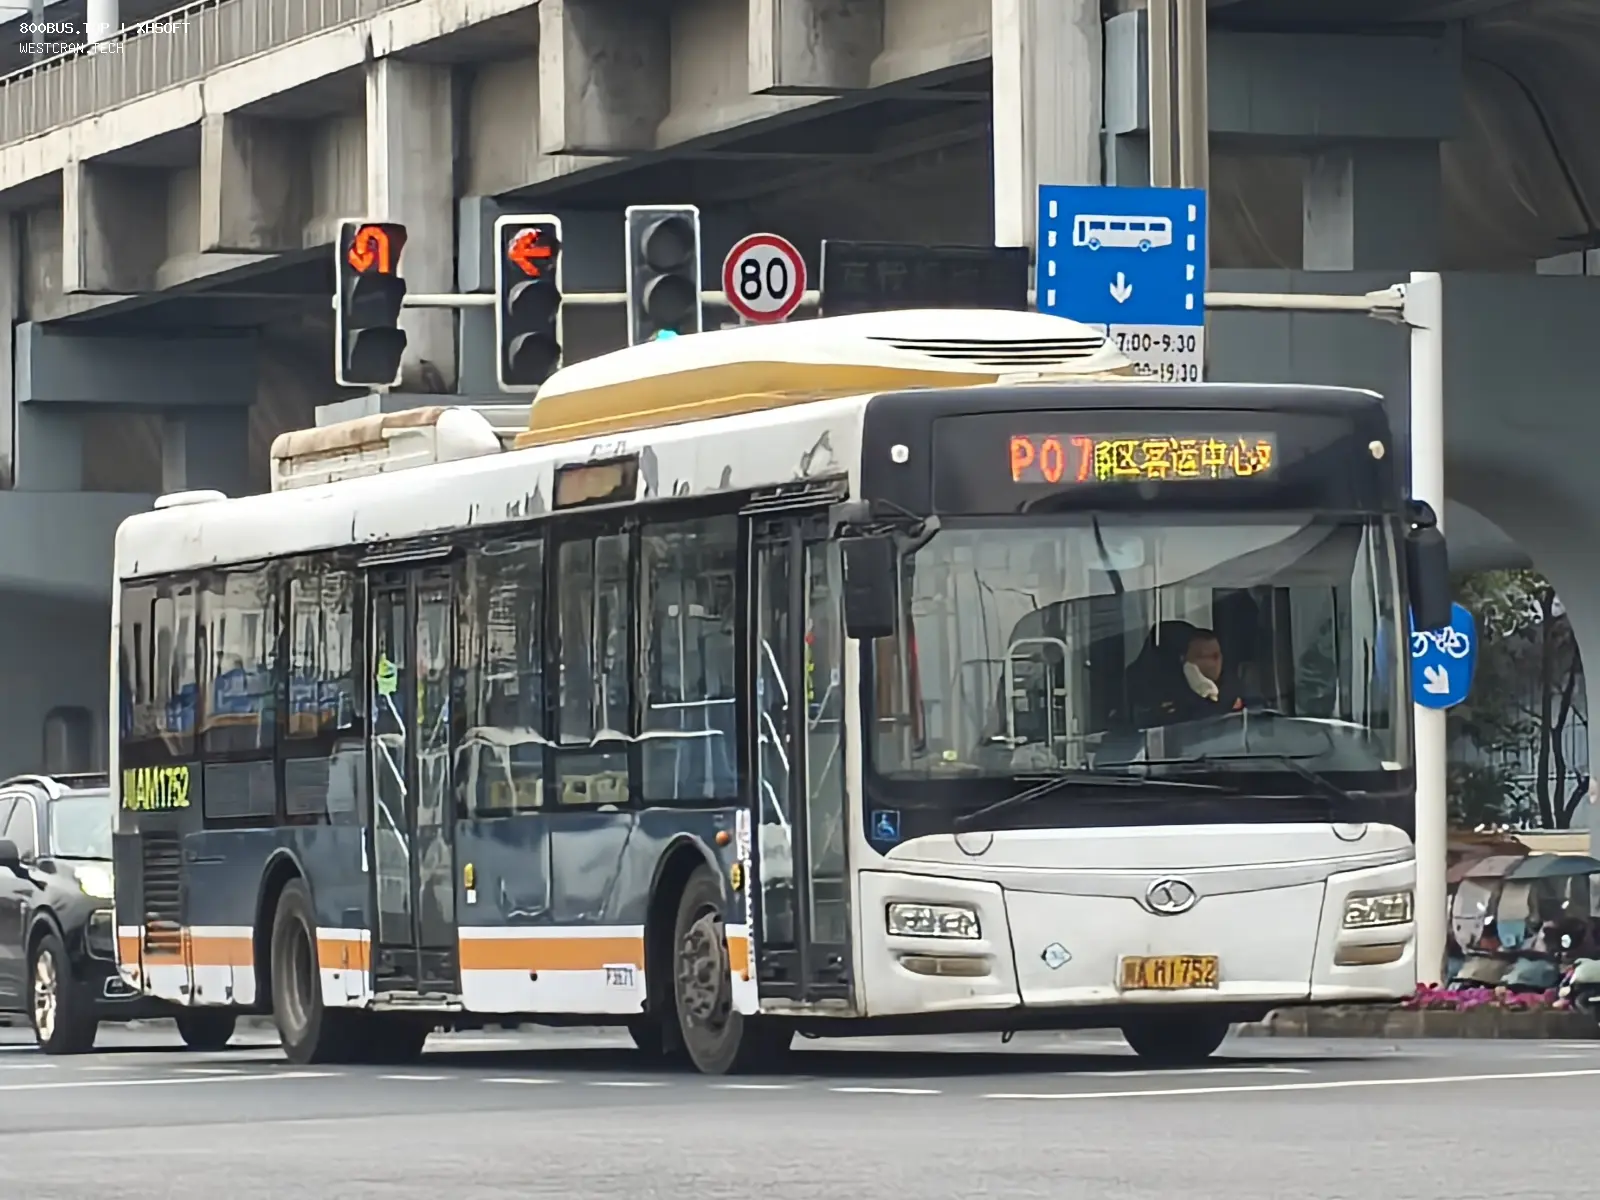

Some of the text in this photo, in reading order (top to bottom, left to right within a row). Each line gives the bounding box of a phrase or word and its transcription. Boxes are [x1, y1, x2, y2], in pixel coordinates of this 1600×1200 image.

[740, 257, 788, 300] 80
[1116, 332, 1196, 353] 7:00-9:30
[1009, 436, 1092, 483] P07
